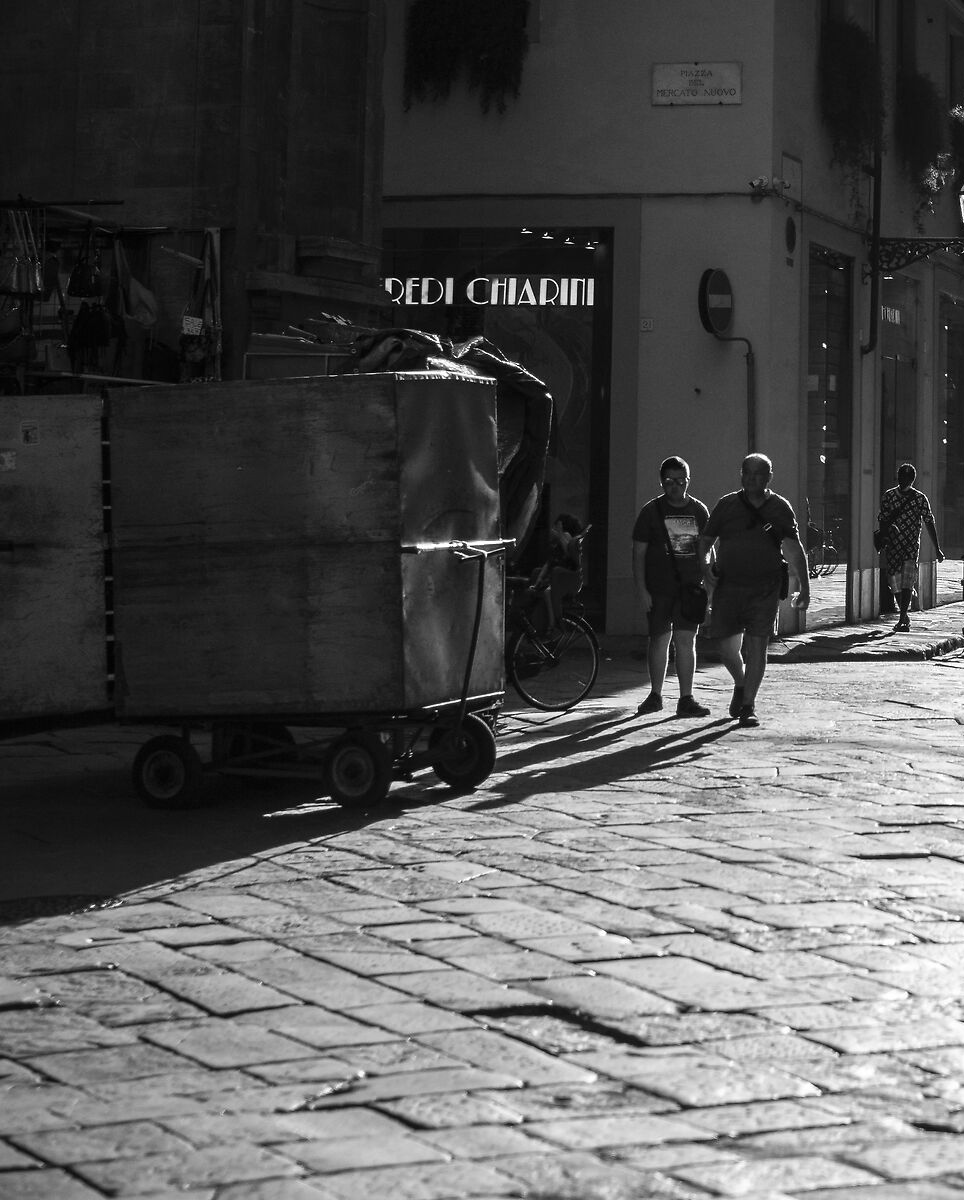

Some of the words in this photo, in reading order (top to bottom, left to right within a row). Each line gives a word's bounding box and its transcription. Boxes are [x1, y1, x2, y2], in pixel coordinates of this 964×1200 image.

[680, 69, 713, 78] PIAZZA
[656, 88, 698, 97] MERCATO
[703, 87, 737, 97] NUOVO
[379, 277, 454, 305] REDI
[466, 277, 595, 306] CHIARINI
